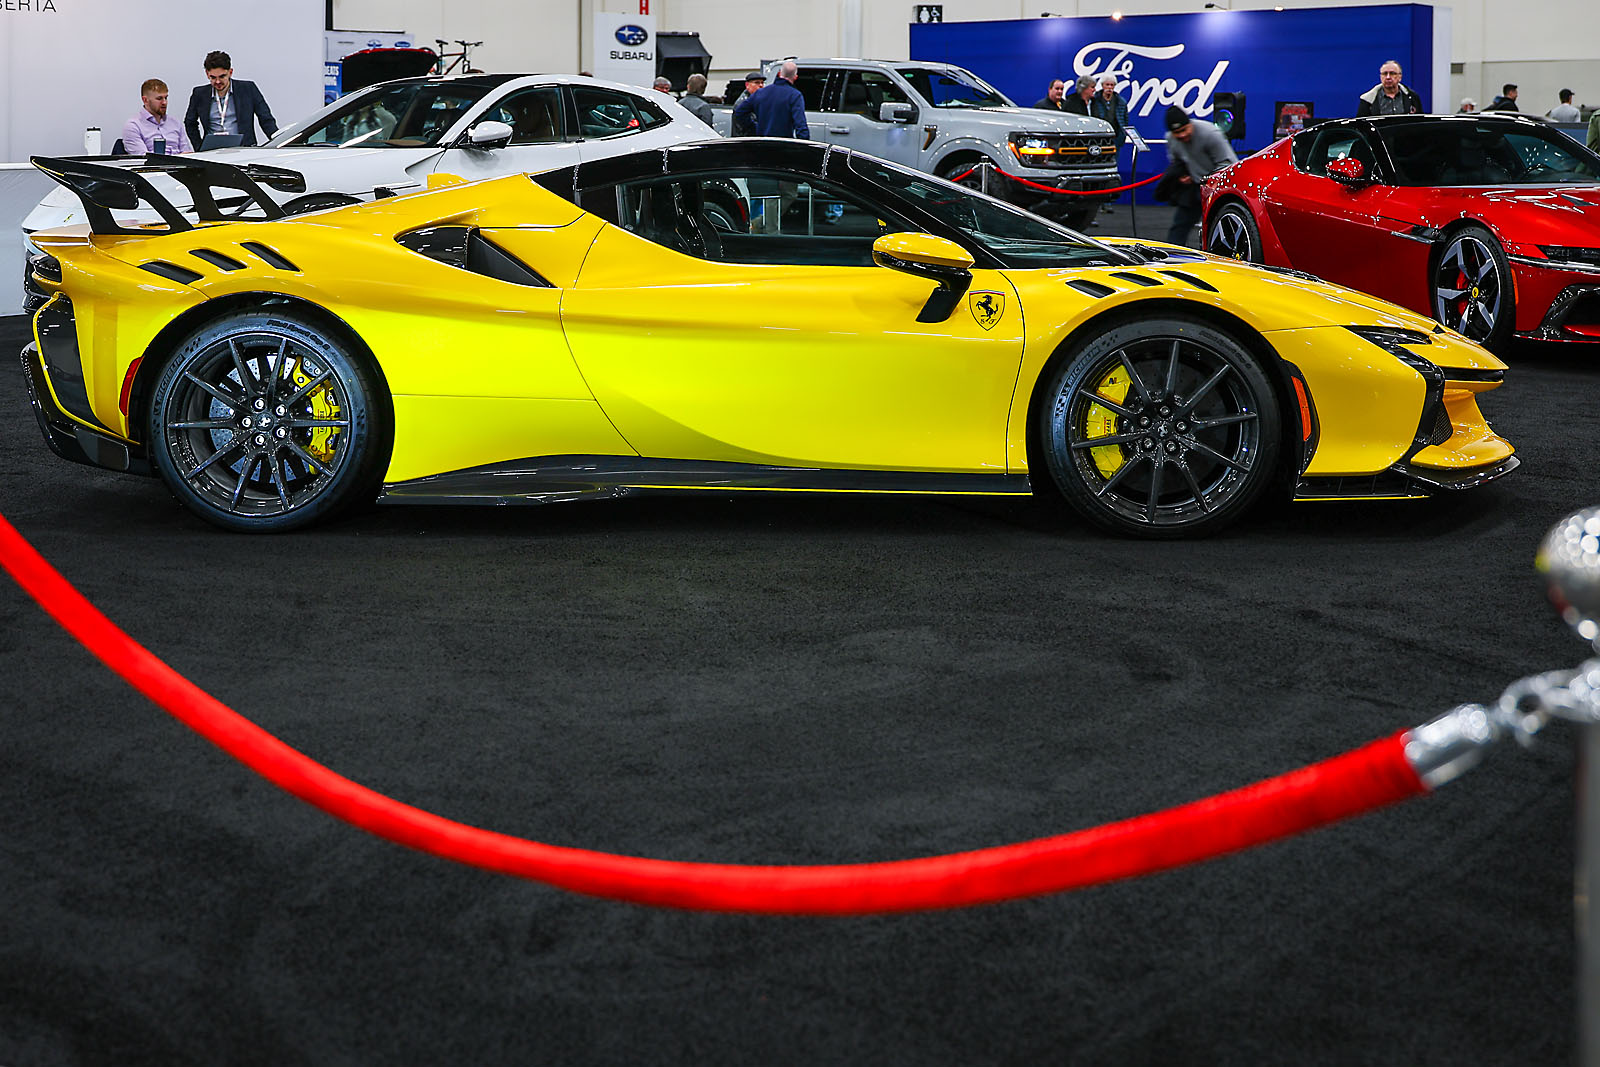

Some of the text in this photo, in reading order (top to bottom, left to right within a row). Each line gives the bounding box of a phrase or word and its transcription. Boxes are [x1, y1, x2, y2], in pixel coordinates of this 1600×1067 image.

[610, 50, 653, 61] SUBARU
[309, 335, 324, 346] Cup
[155, 352, 186, 403] MICHELIN
[1066, 345, 1101, 387] MICHELIN
